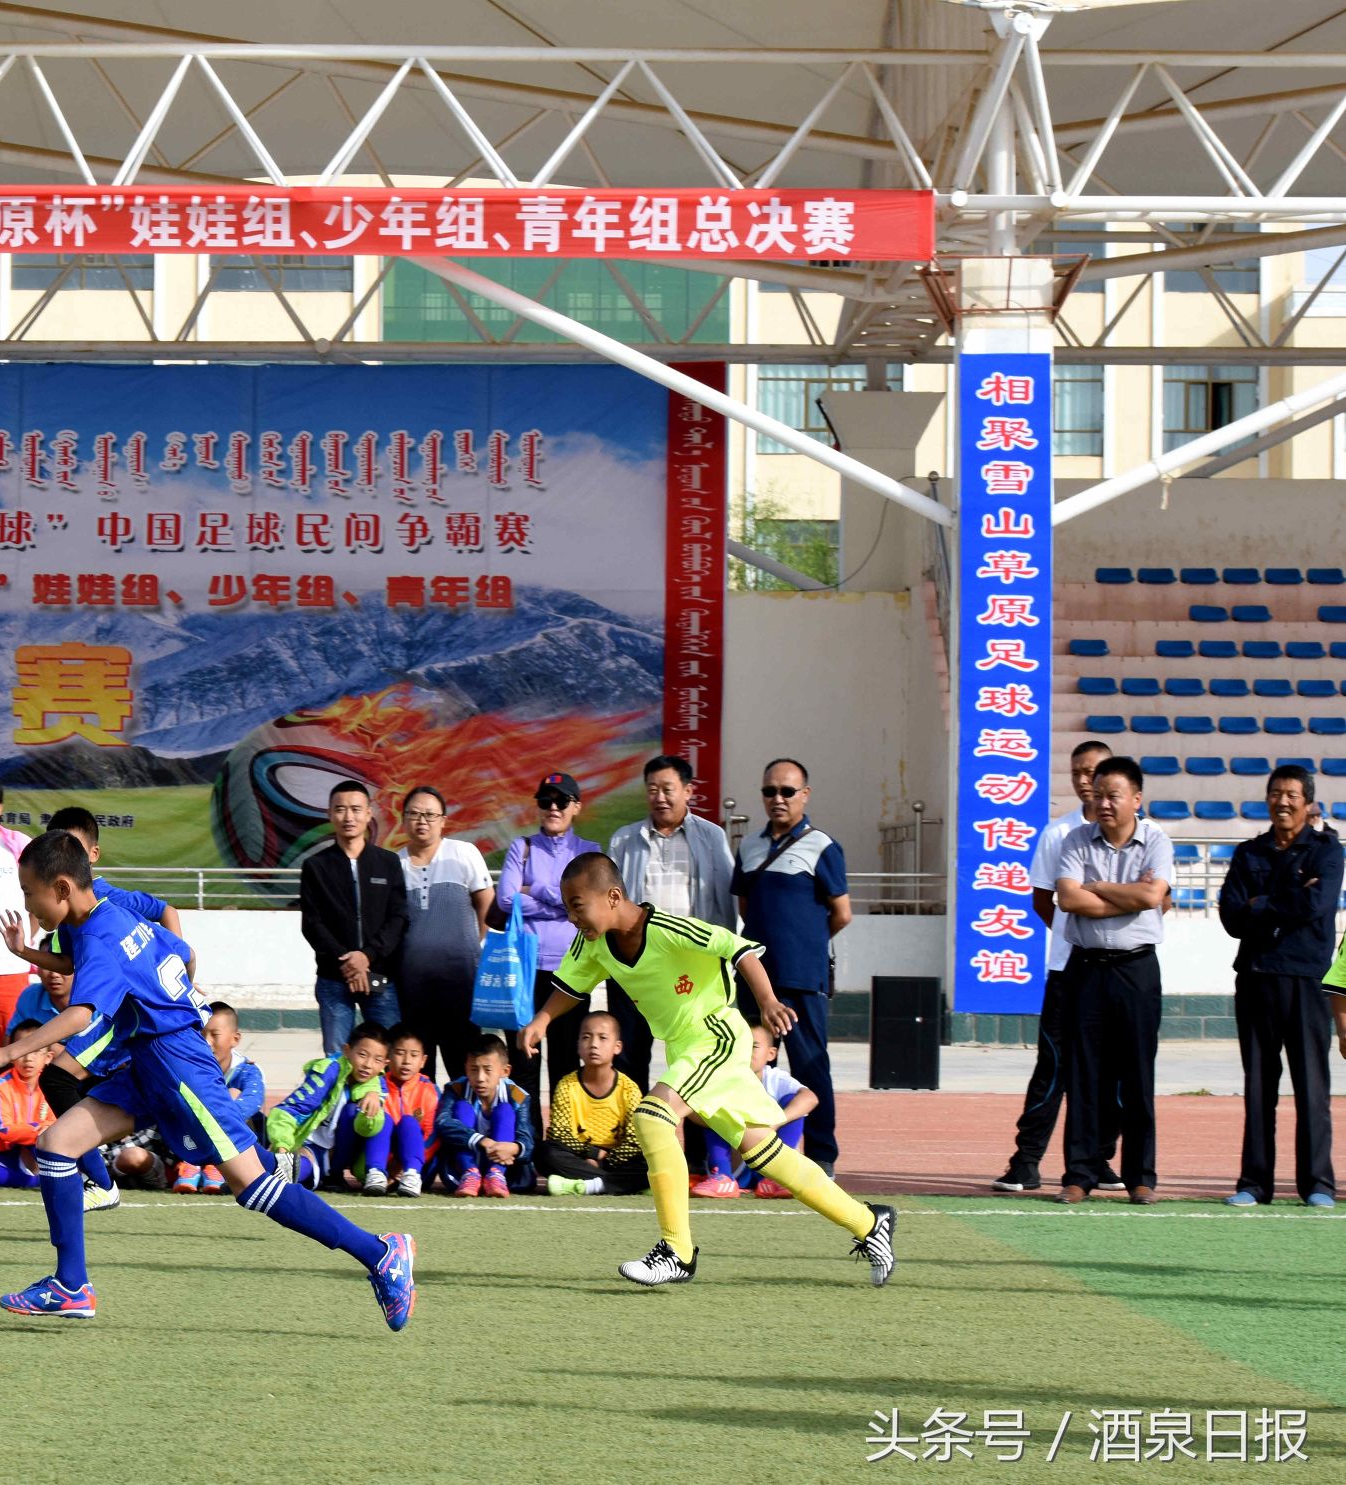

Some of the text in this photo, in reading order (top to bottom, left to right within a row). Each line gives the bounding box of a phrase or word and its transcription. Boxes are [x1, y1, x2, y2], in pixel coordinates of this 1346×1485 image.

[971, 372, 1039, 985] 相聚雪山草原足球运动传递友谊
